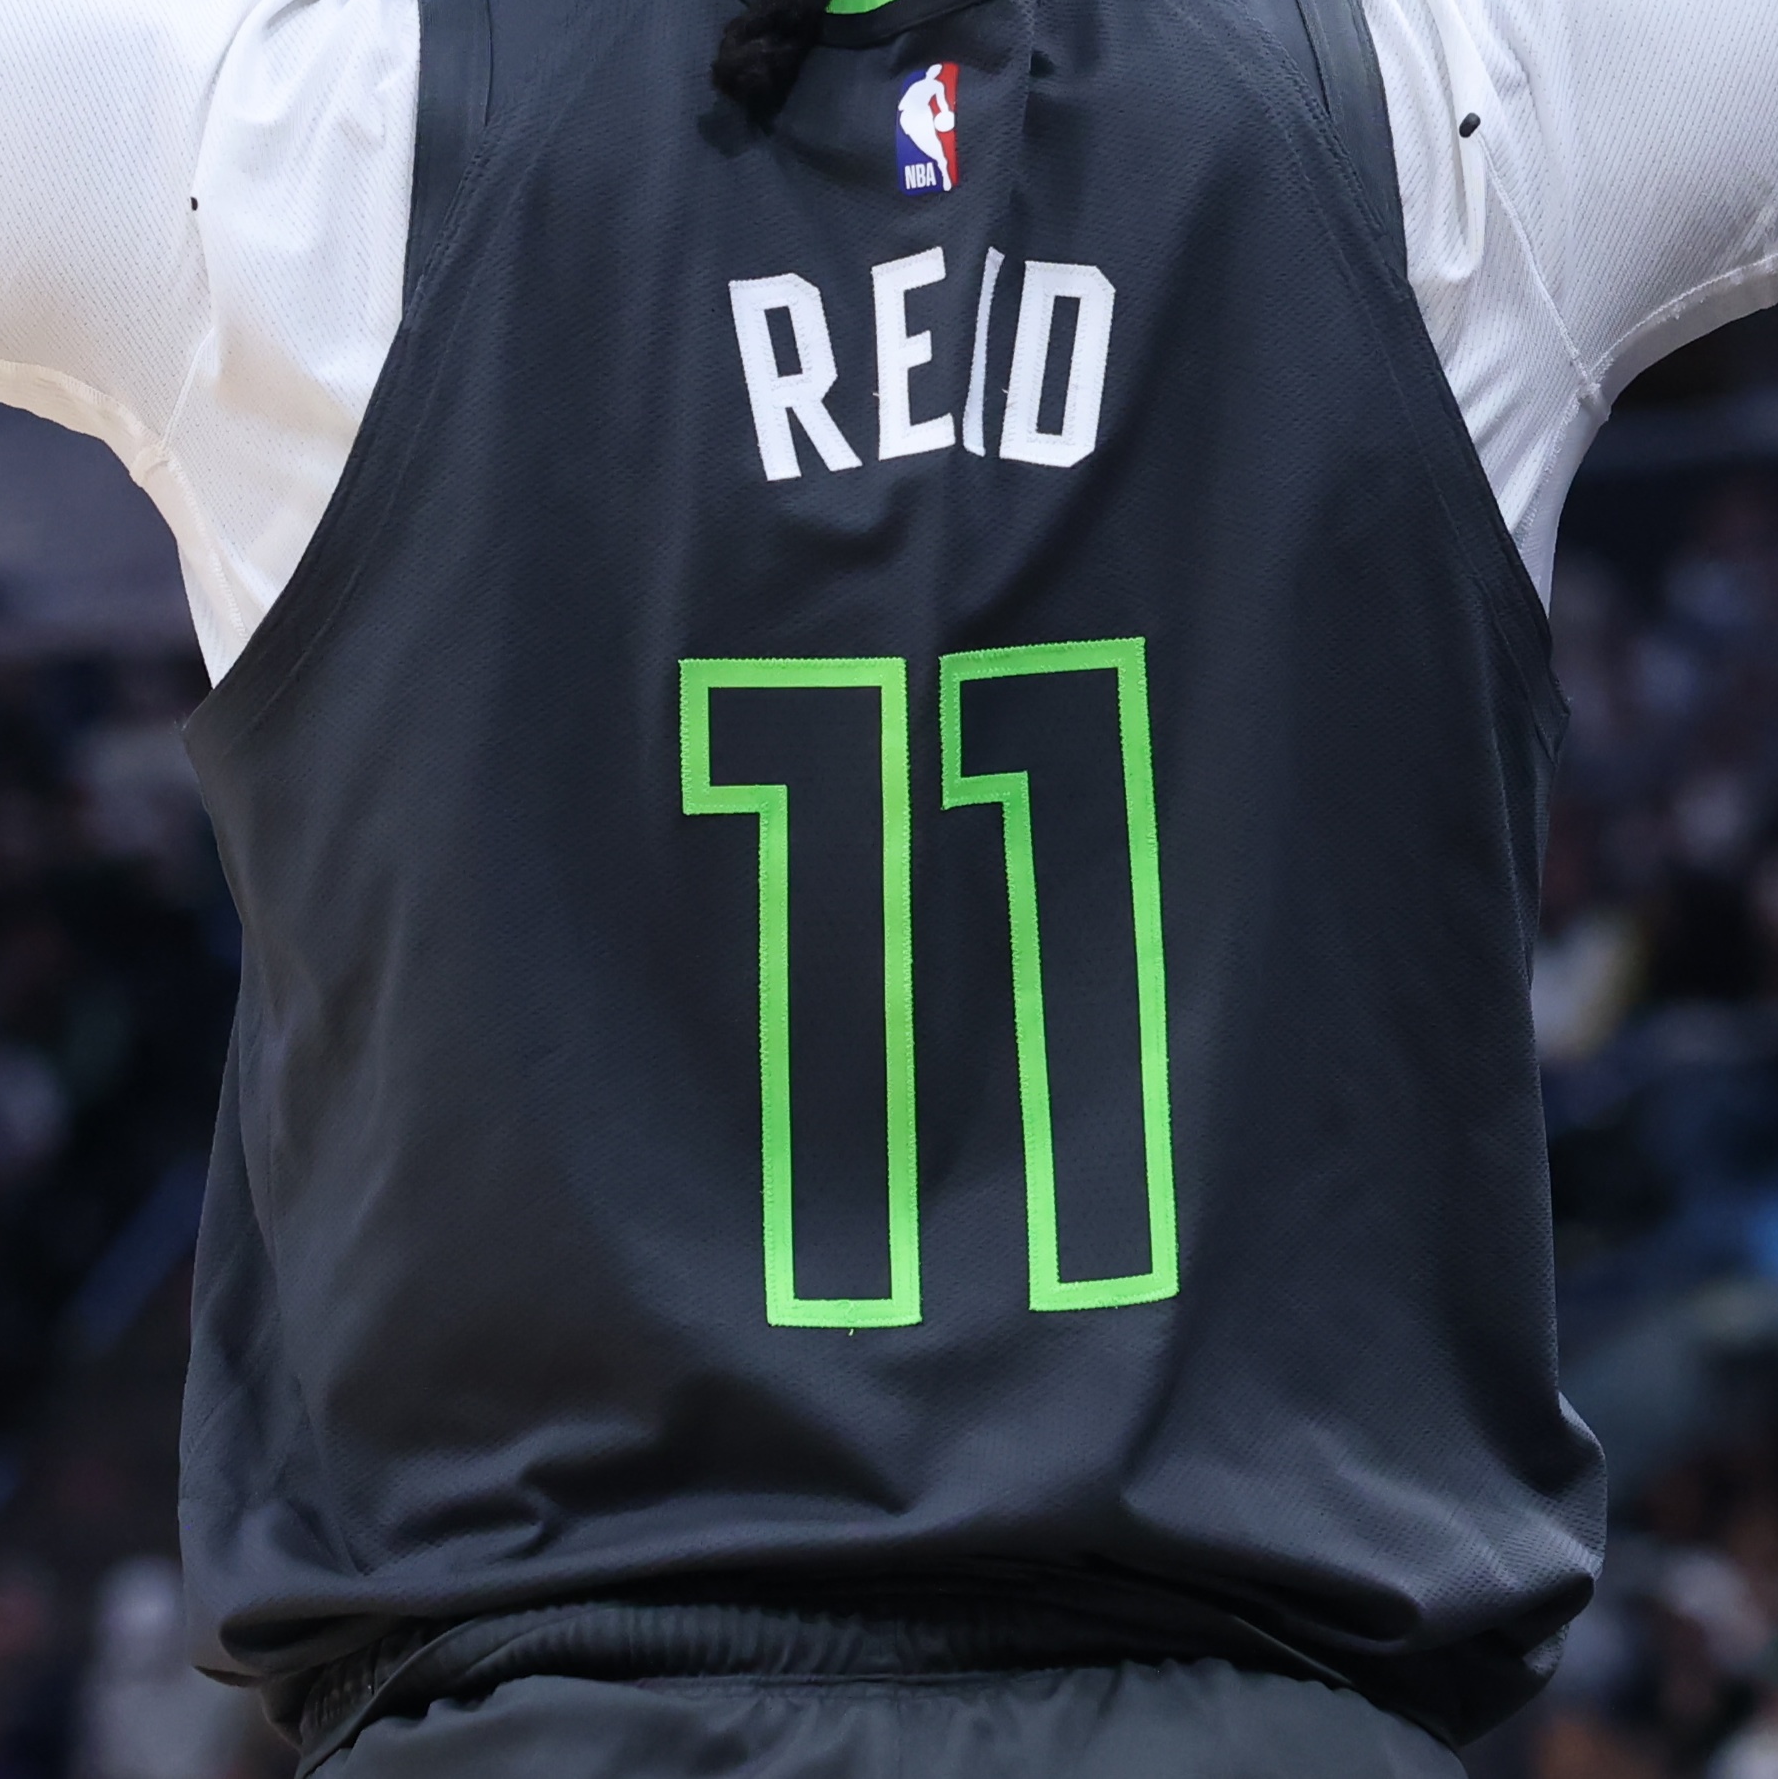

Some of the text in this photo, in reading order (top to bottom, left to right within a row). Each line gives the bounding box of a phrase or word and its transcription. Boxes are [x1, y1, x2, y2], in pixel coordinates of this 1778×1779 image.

[904, 162, 937, 190] NBA
[728, 245, 1116, 481] REID
[678, 636, 1179, 1328] 11
